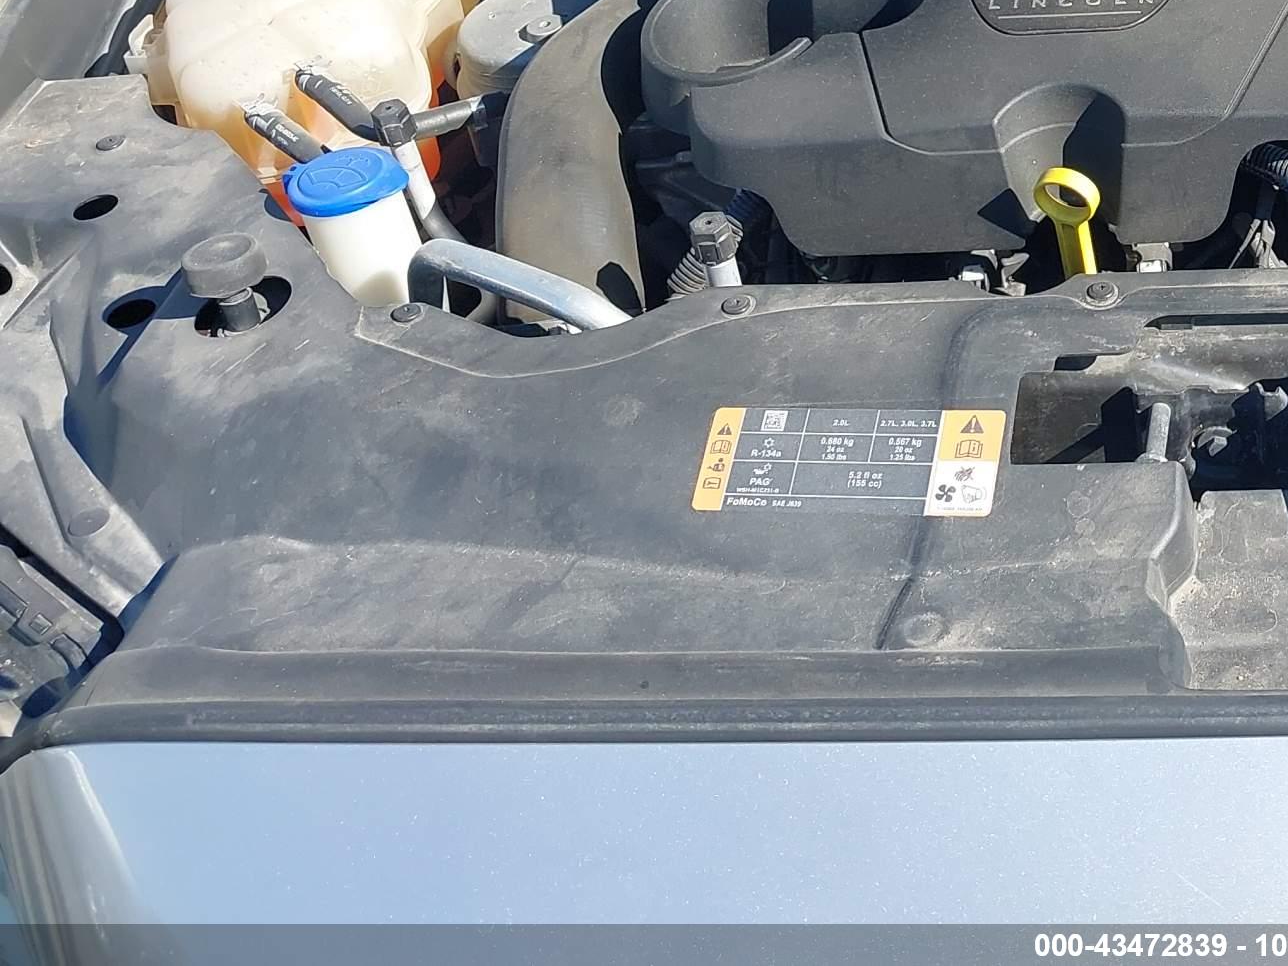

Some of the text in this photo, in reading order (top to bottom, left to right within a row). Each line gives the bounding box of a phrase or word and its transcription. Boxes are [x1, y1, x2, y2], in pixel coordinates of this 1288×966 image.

[843, 436, 855, 447] kg
[911, 437, 922, 447] kg
[750, 449, 782, 458] R-134a
[848, 471, 863, 479] 5.2
[871, 472, 883, 480] oz
[847, 479, 882, 489] (155 cc)
[726, 497, 768, 507] FoMoCo
